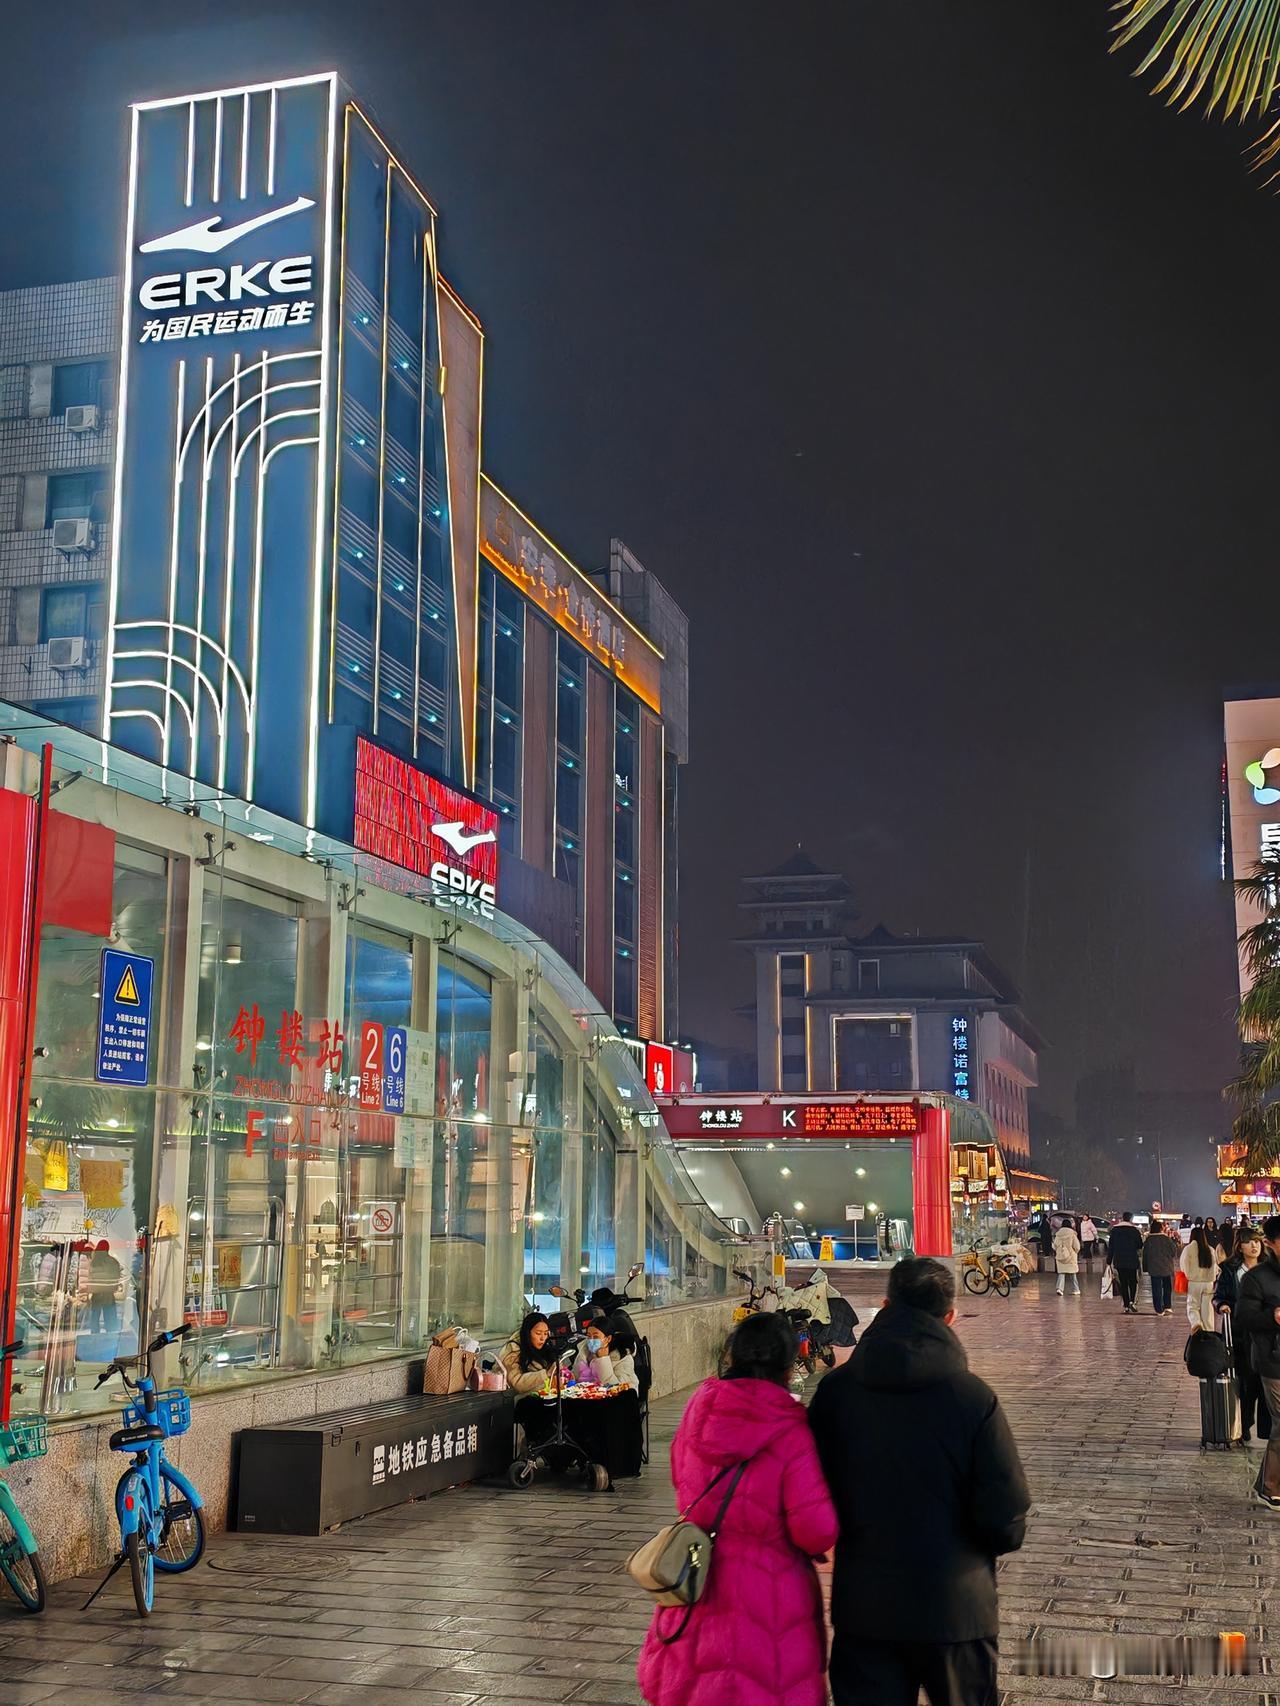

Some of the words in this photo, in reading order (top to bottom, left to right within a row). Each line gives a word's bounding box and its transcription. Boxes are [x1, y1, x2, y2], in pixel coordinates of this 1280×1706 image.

[139, 256, 312, 310] ERKE
[139, 301, 315, 343] 为国民运动而生
[229, 1002, 345, 1075] 钟楼站
[365, 1028, 378, 1069] 2
[390, 1034, 402, 1074] 6
[361, 1072, 381, 1091] 号线
[361, 1093, 374, 1105] Line
[386, 1075, 404, 1095] 号线
[386, 1096, 399, 1108] Line
[699, 1110, 743, 1123] 钟楼站
[782, 1110, 797, 1127] K
[245, 1110, 265, 1158] F
[388, 1424, 478, 1475] 地铁应急备品箱
